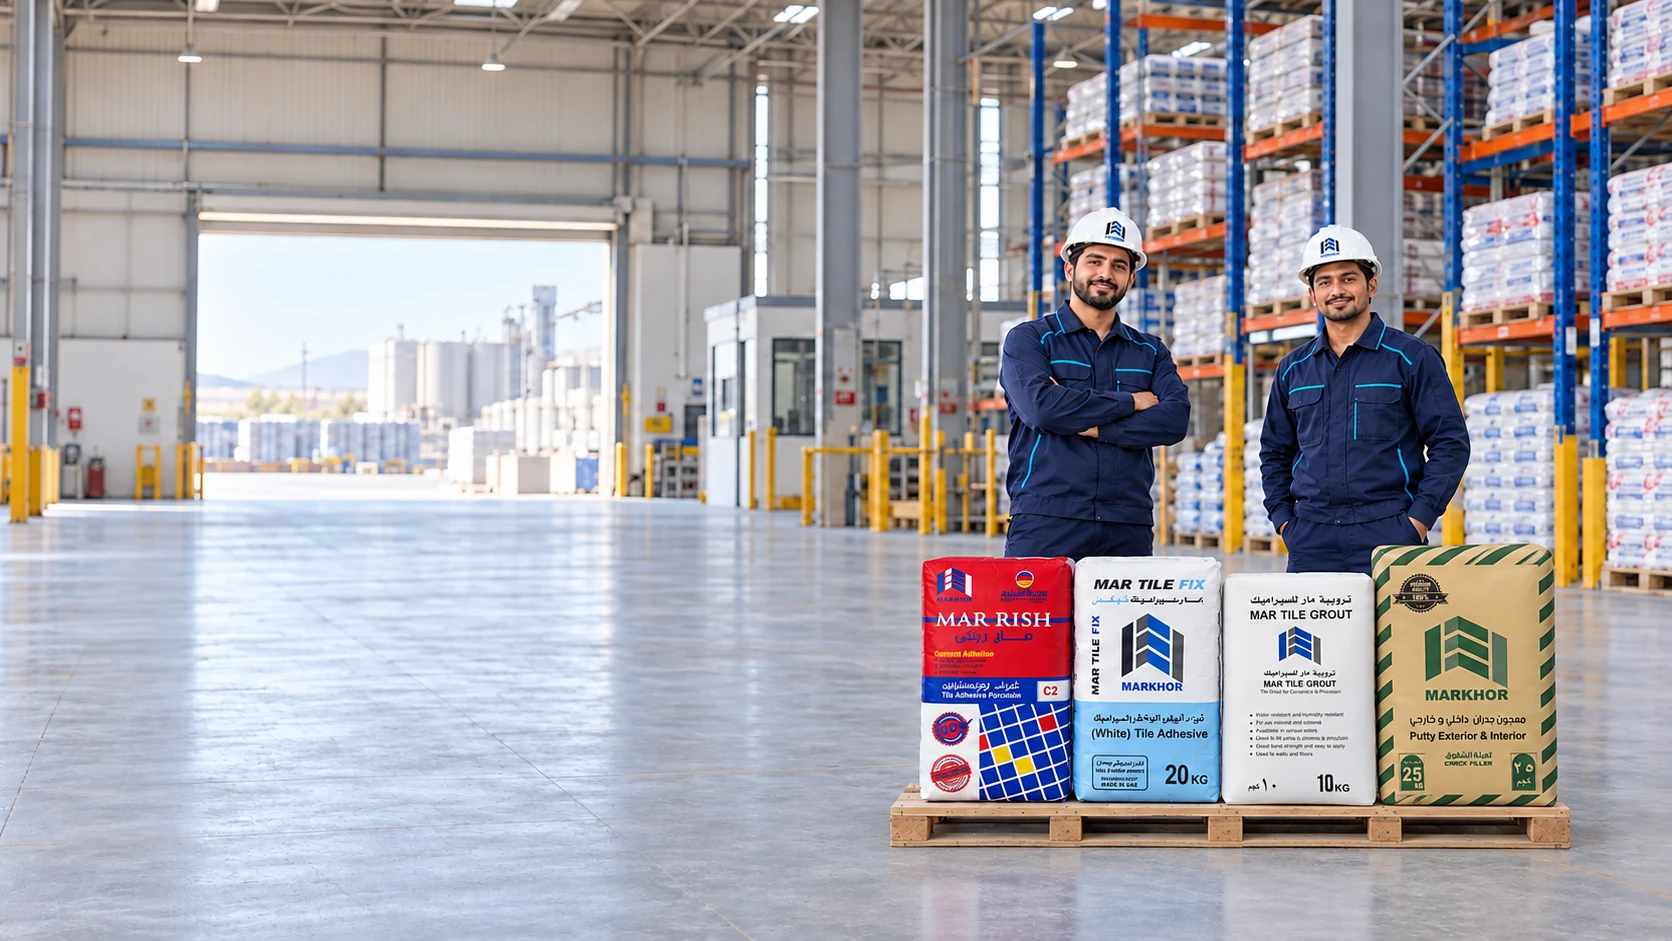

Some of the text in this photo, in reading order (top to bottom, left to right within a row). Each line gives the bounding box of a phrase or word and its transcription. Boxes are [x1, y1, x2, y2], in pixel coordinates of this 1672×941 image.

[1093, 579, 1206, 590] MAR TILE FIX
[935, 612, 1052, 627] MAR RISH
[1250, 609, 1353, 620] MAR TILE GROUT
[1091, 615, 1100, 695] MAR TILE FIX
[1121, 682, 1184, 691] MARKHOR
[1263, 680, 1337, 688] MAR TILE GROUT
[1043, 685, 1058, 696] C2
[1425, 689, 1509, 701] MARKHOR
[1409, 715, 1526, 727] معجون جدران داخلي و خارجي
[1091, 728, 1208, 740] (White) Tile Adhesive
[1409, 731, 1527, 742] Putty Exterior & Interior
[1165, 764, 1208, 785] 20 KG
[1402, 767, 1422, 782] 25
